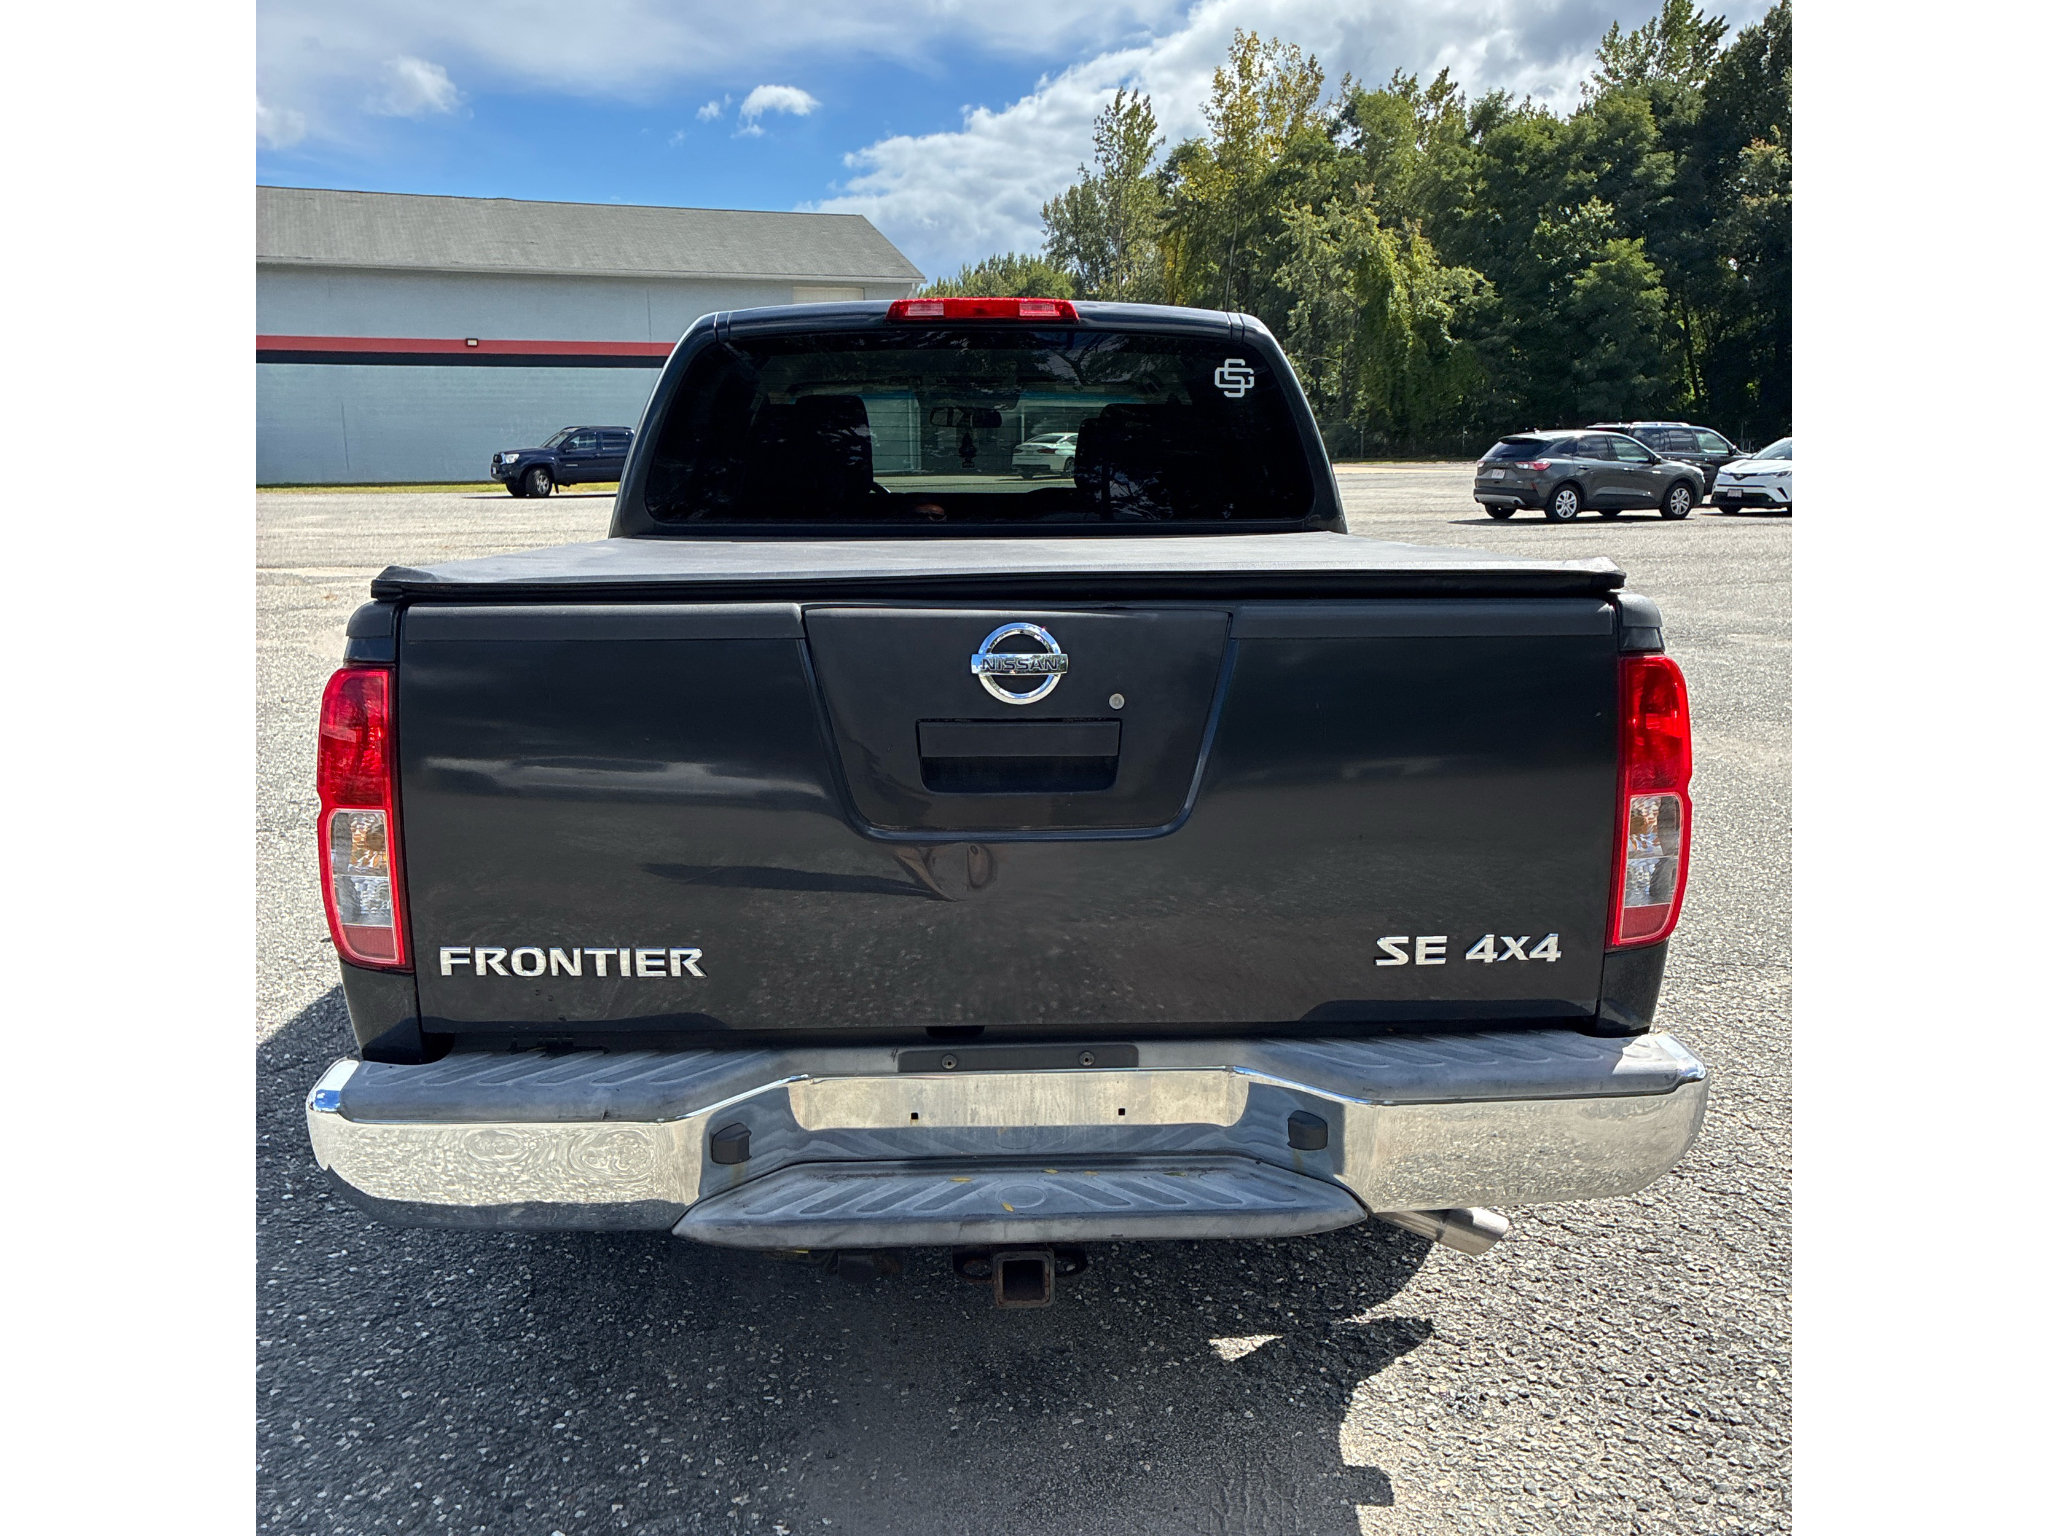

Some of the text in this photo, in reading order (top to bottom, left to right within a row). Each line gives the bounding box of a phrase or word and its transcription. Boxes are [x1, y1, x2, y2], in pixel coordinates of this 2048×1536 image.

[981, 658, 1058, 671] NISSAN
[439, 946, 708, 978] FRONTIER
[1375, 935, 1448, 966] SE
